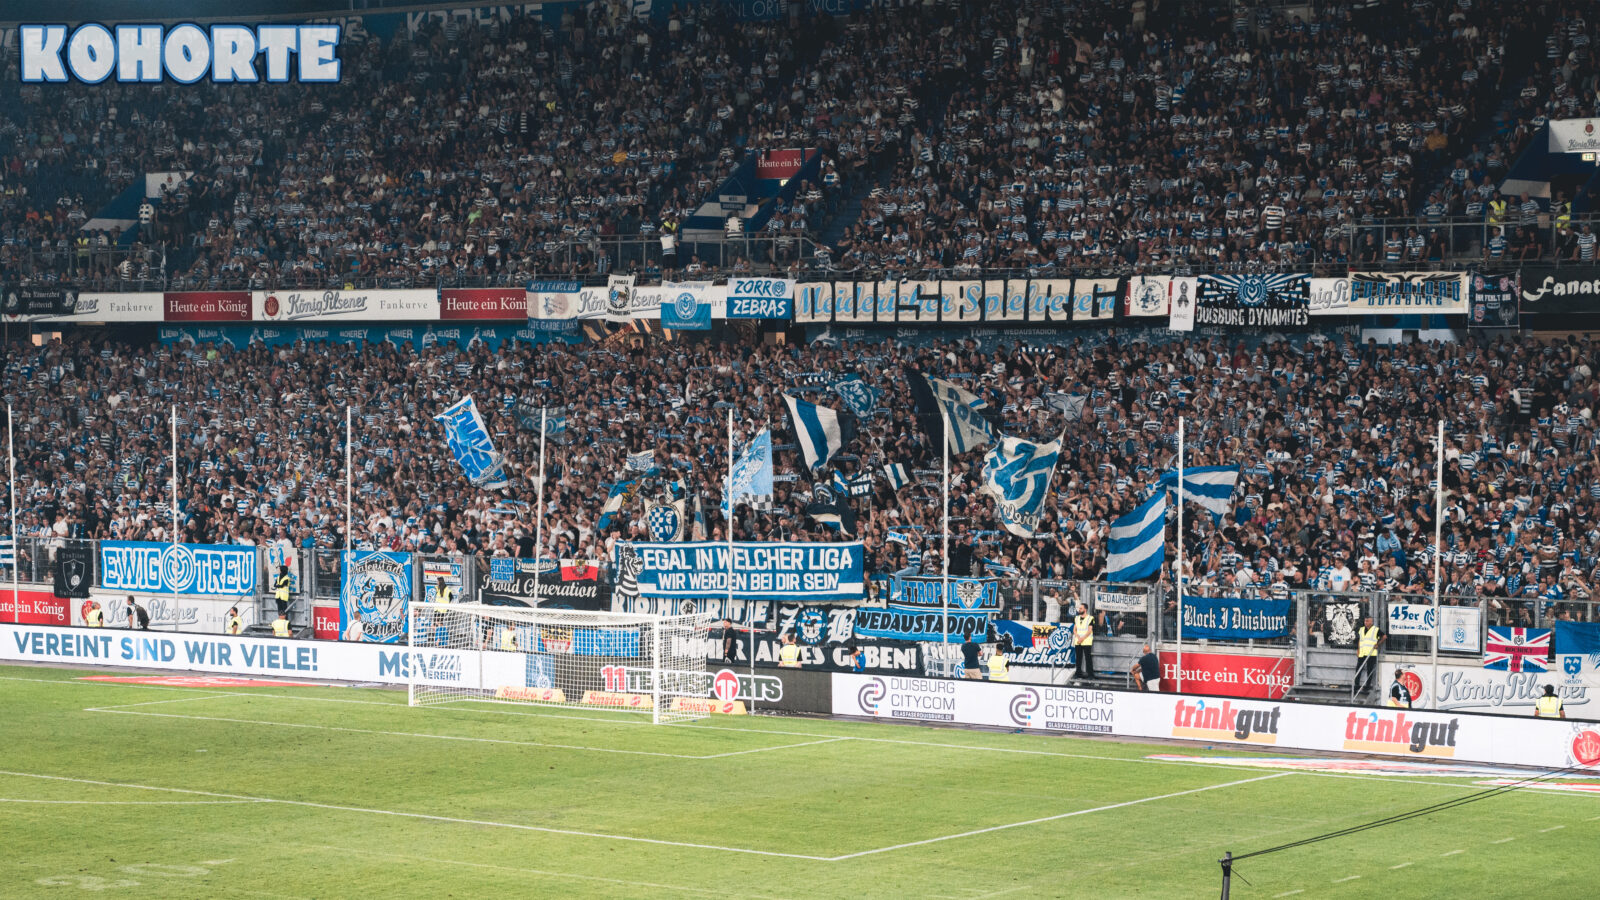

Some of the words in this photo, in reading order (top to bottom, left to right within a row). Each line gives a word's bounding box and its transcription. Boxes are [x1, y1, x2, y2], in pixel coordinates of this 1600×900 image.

[780, 160, 792, 168] ein
[1350, 281, 1461, 302] COMUNIDAD
[109, 302, 153, 312] Fankurve
[169, 301, 199, 313] Heute
[201, 302, 215, 313] ein
[218, 301, 248, 317] König
[380, 301, 428, 310] Fankurve
[446, 297, 479, 311] Heute
[481, 298, 497, 310] ein
[500, 296, 528, 311] Köni
[733, 299, 786, 318] ZEBRAS
[1197, 307, 1245, 324] DUISBURG
[1248, 307, 1309, 326] DYNAMITES
[1004, 328, 1057, 336] WEDAUSTADION
[643, 548, 692, 570] EGAL
[693, 548, 712, 570] IN
[713, 548, 804, 570] WELCHER
[809, 548, 853, 570] LIGA
[102, 546, 162, 589] EWIG
[193, 547, 255, 593] TREU
[481, 573, 520, 594] Proud
[524, 579, 598, 598] Gneration
[658, 572, 686, 590] WIR
[688, 572, 747, 590] WERDEN
[750, 573, 773, 590] BEI
[776, 573, 800, 590] DIR
[803, 572, 839, 591] SEIN
[981, 581, 998, 603] 47
[17, 602, 32, 614] ein
[34, 602, 65, 620] König
[1183, 604, 1217, 628] Block
[1232, 608, 1288, 633] Duisburg
[1390, 605, 1420, 620] 45er
[316, 616, 339, 632] Heu
[856, 610, 987, 635] WEDAUSTADION
[14, 632, 112, 658] VEREINT
[120, 637, 176, 663] SIND
[184, 641, 233, 666] WIR
[239, 644, 319, 671] VIELE!
[891, 678, 955, 694] DUISBURG
[1163, 663, 1211, 682] Heute
[1214, 667, 1239, 683] ein
[1242, 667, 1292, 694] König
[502, 686, 537, 700] Sinalco
[588, 691, 625, 706] Sinalco
[1045, 688, 1114, 705] DUISBURG
[678, 697, 716, 713] Sinalco
[891, 694, 955, 711] CITYCOM
[1045, 704, 1114, 722] CITYCOM
[1173, 699, 1281, 740] trinkgut
[1345, 711, 1460, 753] trinkgut
